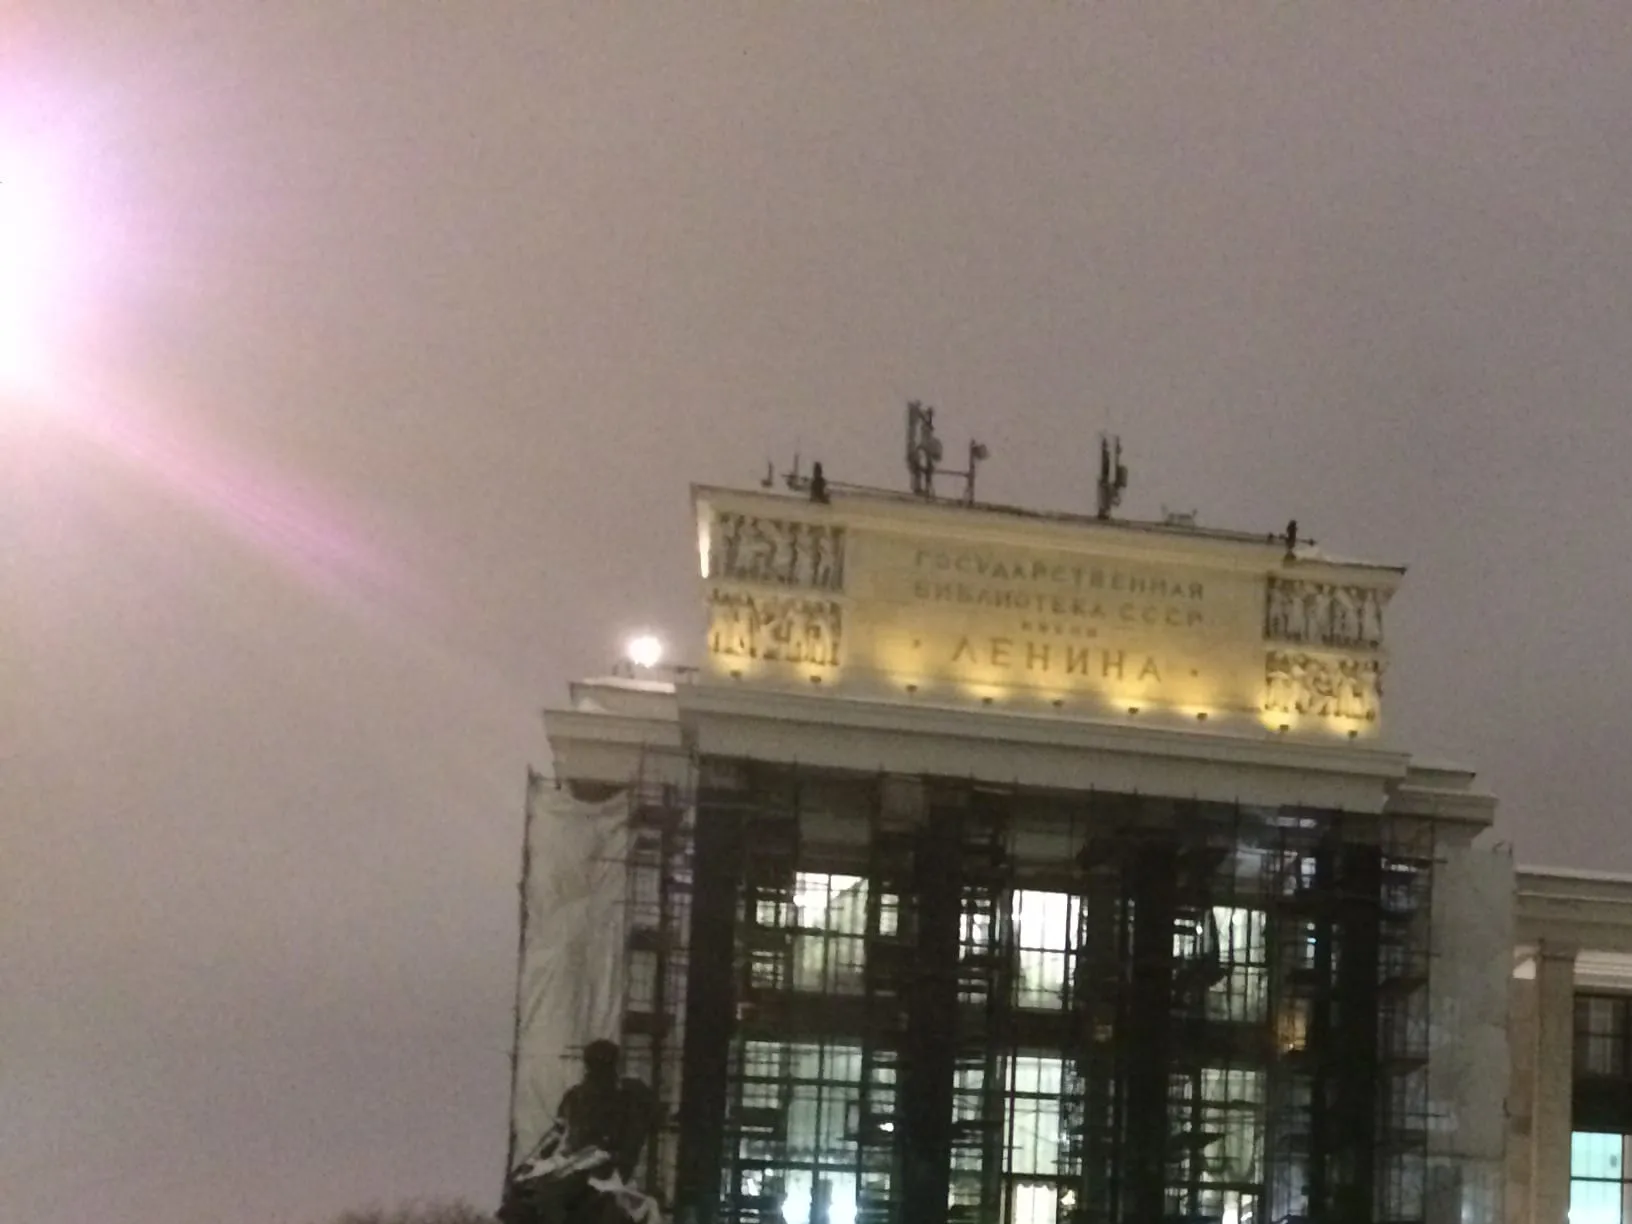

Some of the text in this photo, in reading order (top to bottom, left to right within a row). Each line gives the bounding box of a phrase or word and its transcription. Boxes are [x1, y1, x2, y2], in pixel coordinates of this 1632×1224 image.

[913, 549, 1204, 600] ГОСУДАРСТВЕННАЯ
[1118, 602, 1204, 627] СССР
[952, 636, 1162, 683] ЛЕНИНА
